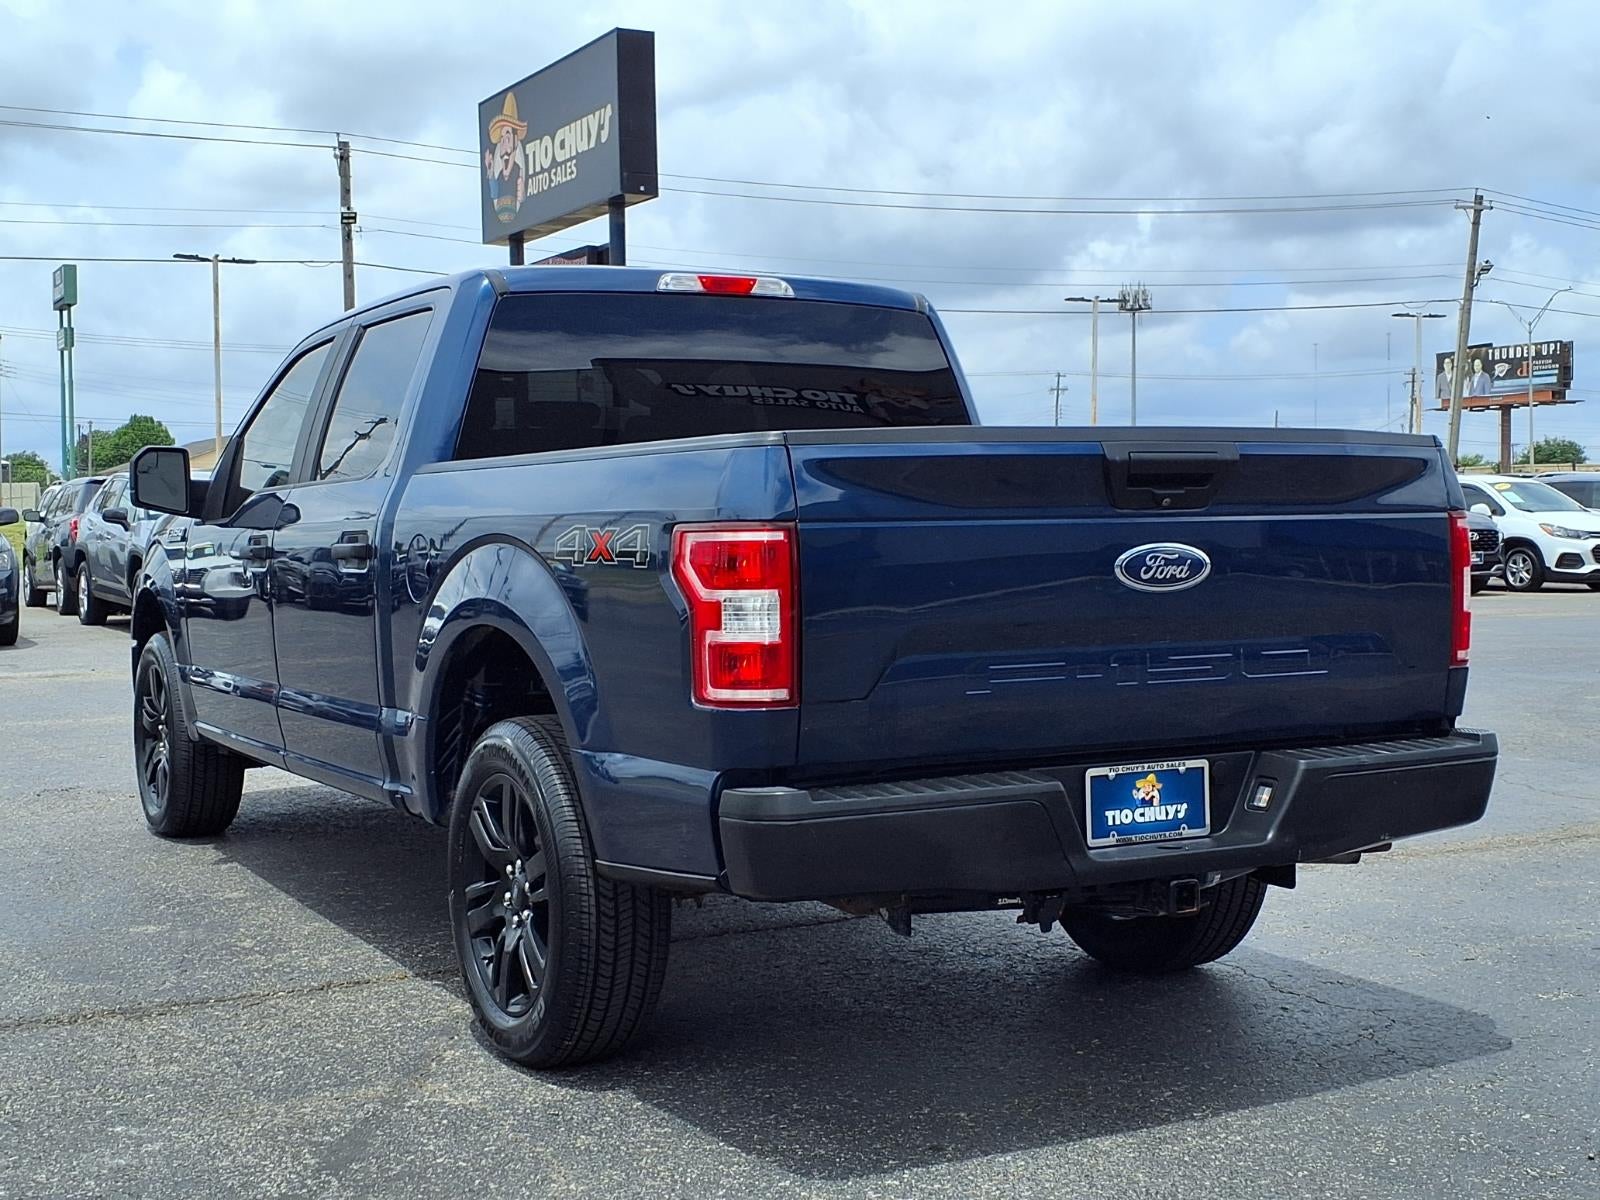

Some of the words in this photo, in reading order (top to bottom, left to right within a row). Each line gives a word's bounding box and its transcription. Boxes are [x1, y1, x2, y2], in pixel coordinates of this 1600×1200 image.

[526, 135, 551, 175] TIO
[554, 103, 612, 162] CHUY'S
[527, 172, 550, 196] AUTO
[550, 159, 577, 186] SALES
[1488, 344, 1536, 361] THUNDER
[1541, 342, 1561, 356] UP!
[1140, 553, 1191, 580] Ford
[1121, 765, 1146, 773] CHUY'S
[1146, 763, 1165, 771] AUTO
[1165, 761, 1187, 769] SALES
[1115, 831, 1183, 844] WWW.TIOCHUYS.COM
